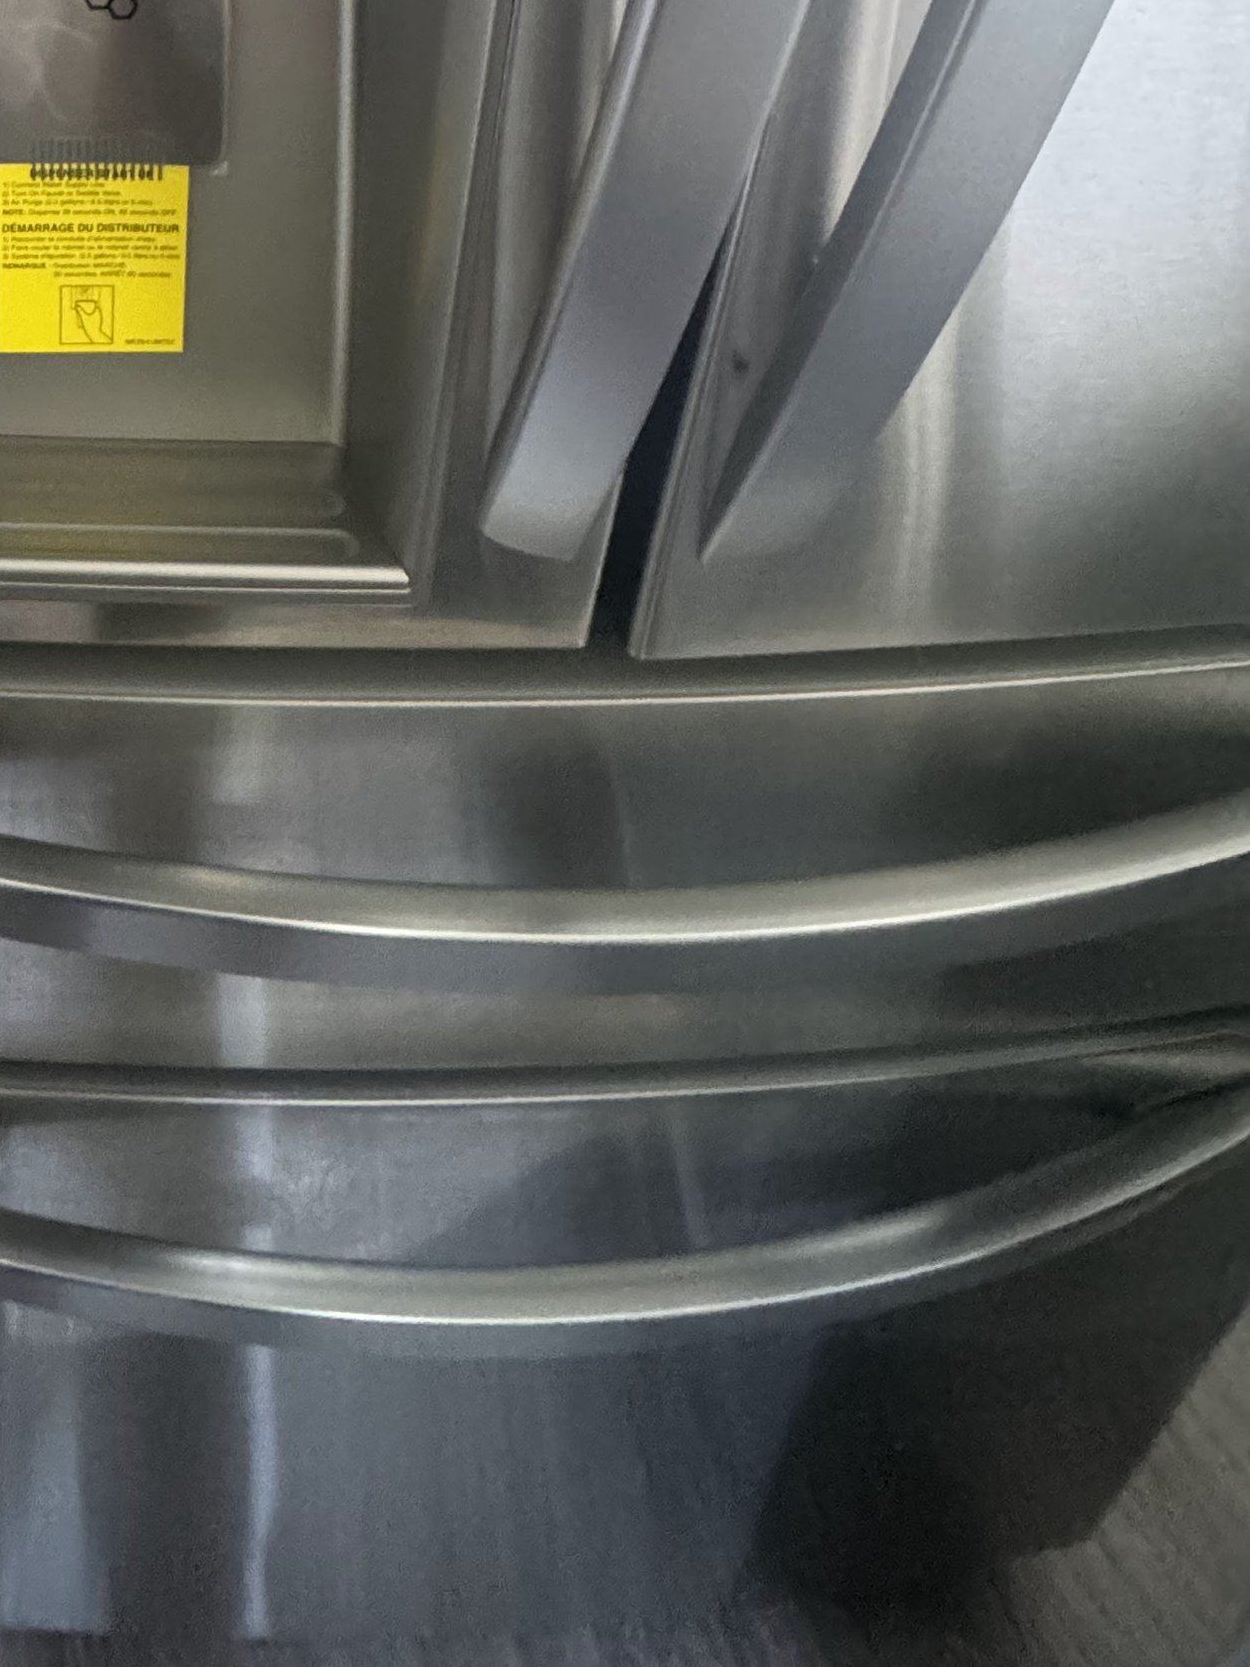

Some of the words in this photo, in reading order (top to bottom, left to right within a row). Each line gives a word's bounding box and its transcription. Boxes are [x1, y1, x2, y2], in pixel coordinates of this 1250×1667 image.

[1, 222, 75, 233] DÉMARRAGE
[77, 223, 94, 233] DU
[97, 223, 180, 233] DISTRIBUTEUR
